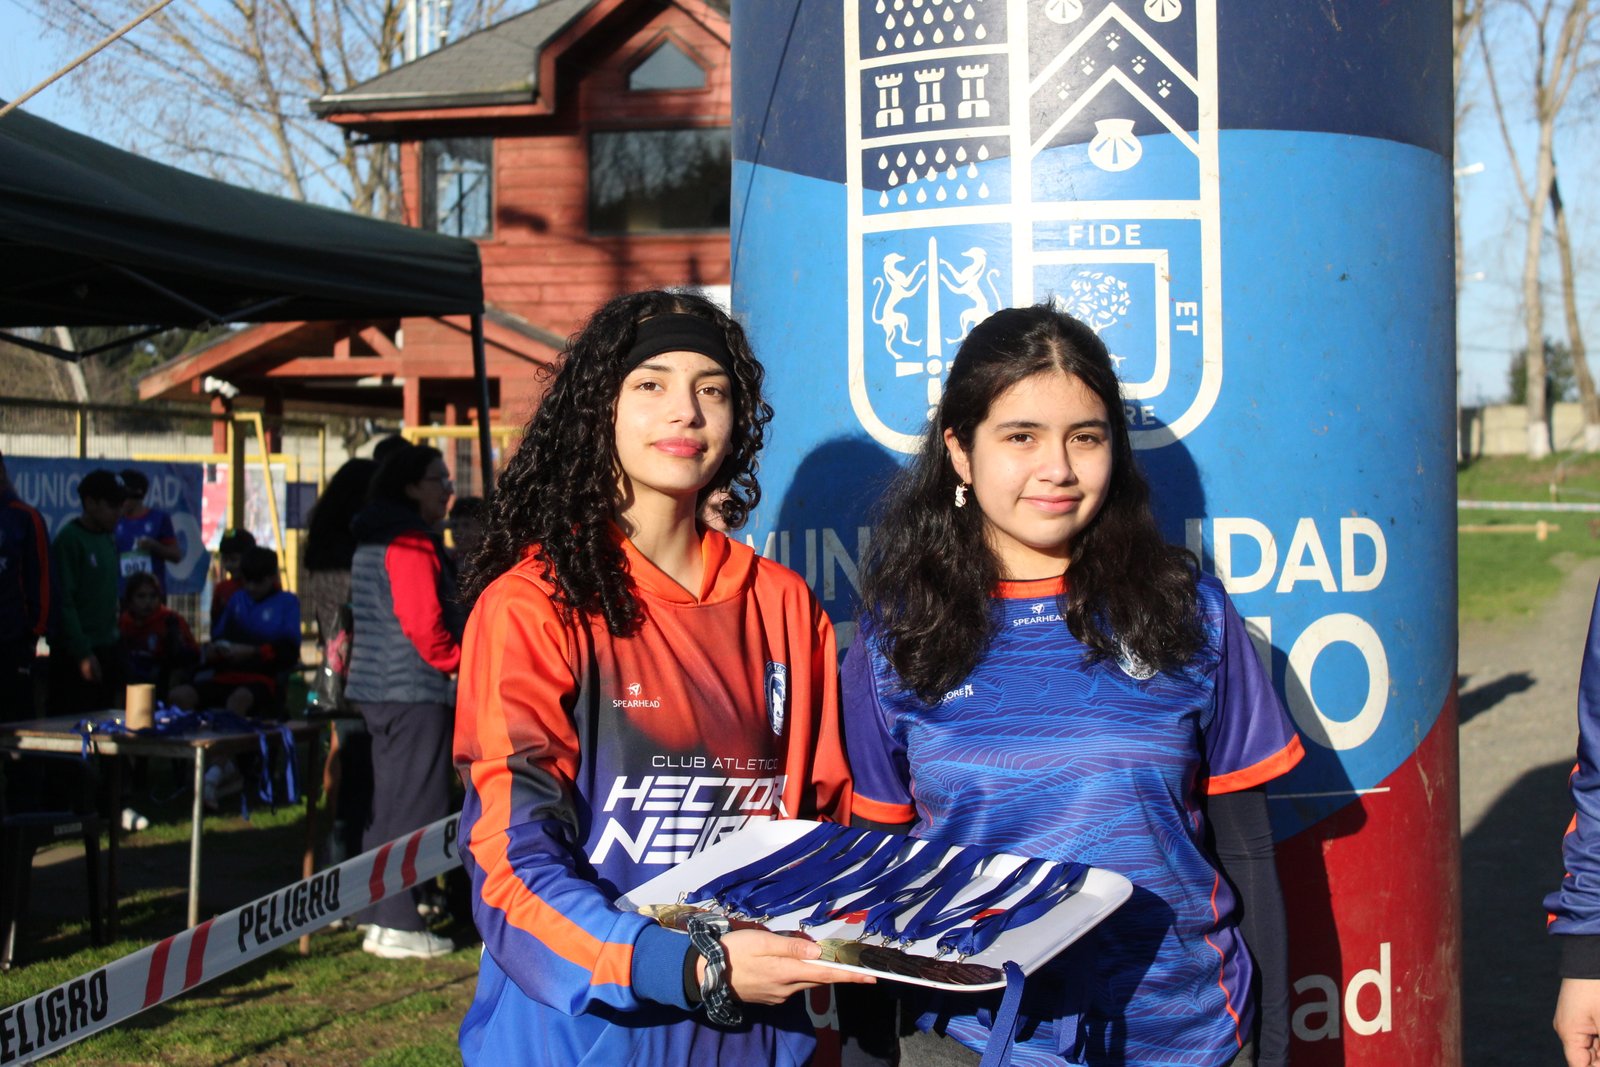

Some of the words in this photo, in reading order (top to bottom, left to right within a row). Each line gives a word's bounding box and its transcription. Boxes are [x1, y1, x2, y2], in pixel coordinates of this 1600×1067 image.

[1068, 224, 1141, 246] FIDE
[1176, 301, 1198, 336] ET
[612, 698, 660, 709] SPEARHEAD
[939, 687, 965, 702] CORE
[651, 755, 707, 769] CLUB
[711, 756, 779, 771] ATLETICO
[602, 774, 790, 818] HECTOR
[588, 814, 778, 864] NEIR
[237, 867, 341, 952] PELIGRO
[0, 968, 109, 1065] ELIGRO
